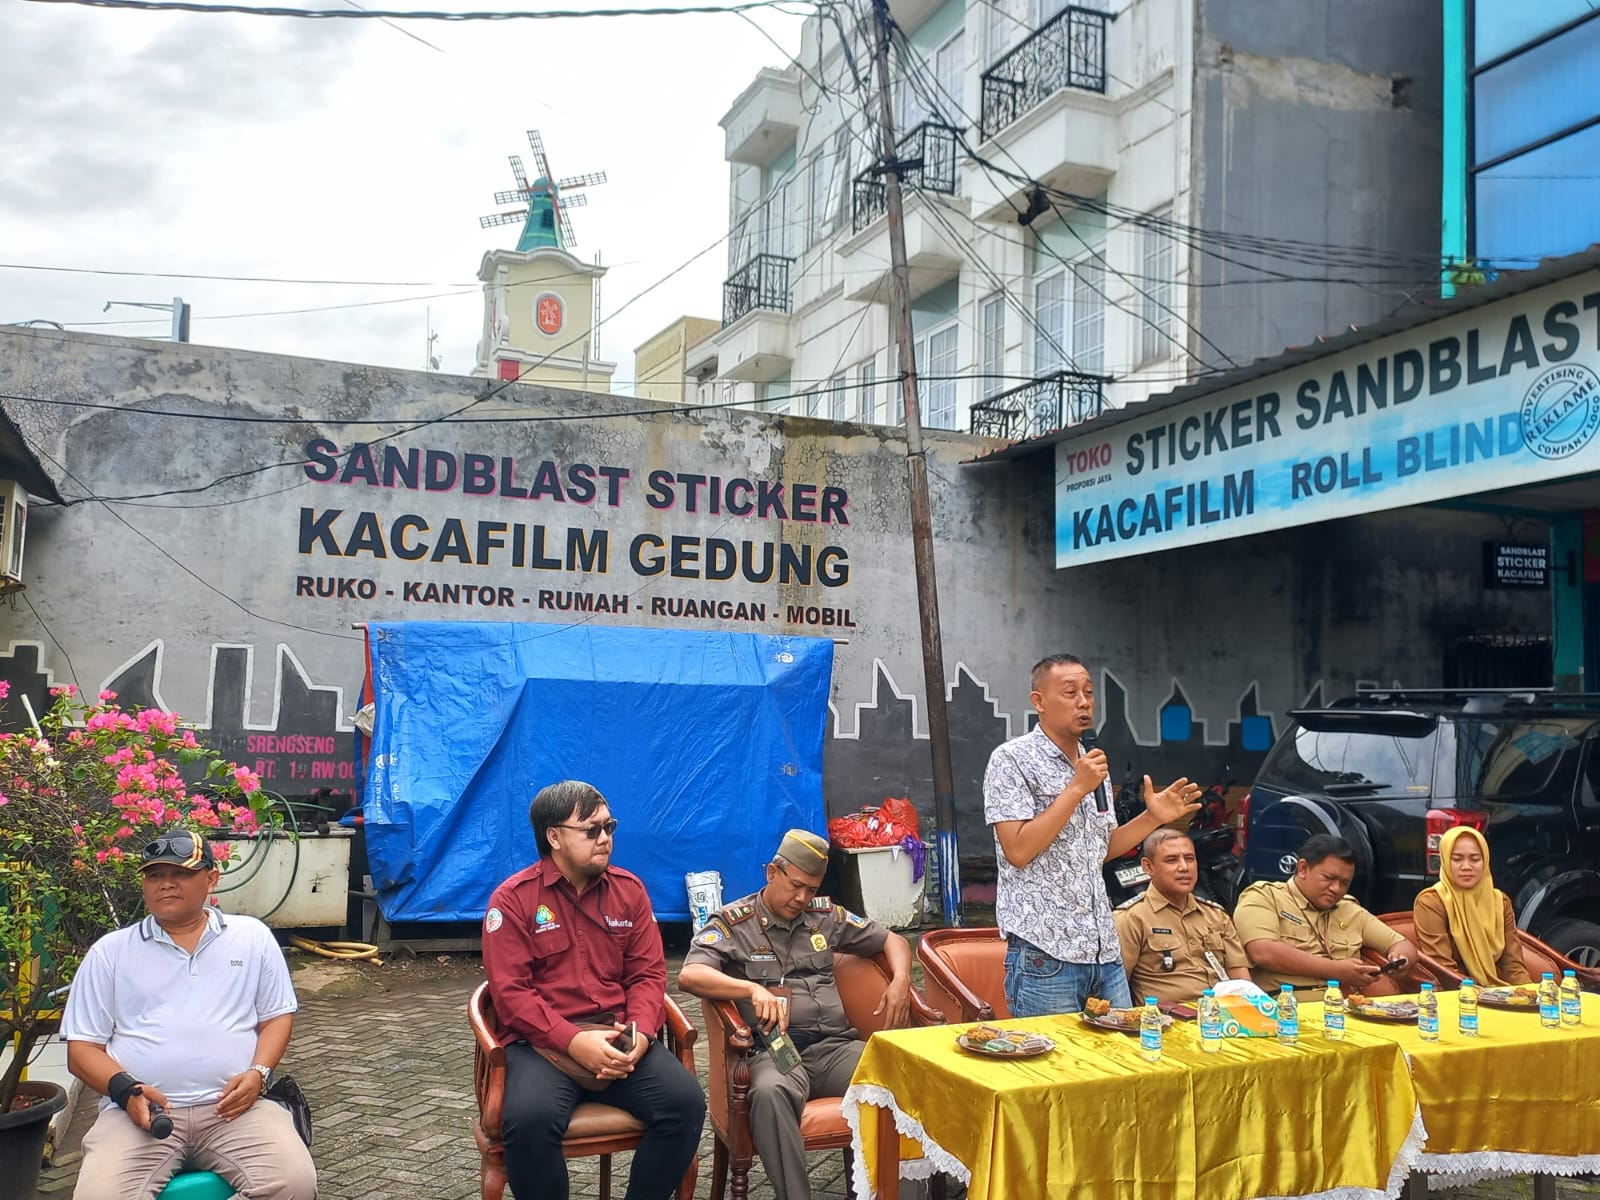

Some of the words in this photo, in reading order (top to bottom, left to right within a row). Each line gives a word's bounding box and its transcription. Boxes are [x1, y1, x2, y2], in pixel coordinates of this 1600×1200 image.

[1523, 368, 1584, 426] ADVERTISING
[1526, 378, 1597, 444] REKLAME
[1125, 391, 1282, 477] STICKER
[1537, 430, 1588, 455] COMPANY
[1587, 395, 1600, 430] LOGO
[303, 438, 630, 508] SANDBLAST
[645, 469, 850, 526] STICKER
[1066, 443, 1112, 475] TOKO
[1073, 469, 1256, 550] KACAFILM
[1291, 447, 1383, 500] ROLL
[1396, 411, 1524, 478] BLIND
[298, 506, 610, 575] KACAFILM
[629, 533, 851, 588] GEDUNG
[1497, 556, 1546, 569] STICKER
[1497, 569, 1544, 580] KACAFILM
[1500, 546, 1546, 557] SANDBLAST
[296, 575, 377, 600] RUKO
[402, 581, 515, 609] KANTOR
[538, 590, 630, 615] RUMAH
[651, 597, 767, 623] RUANGAN
[787, 604, 857, 628] MOBIL
[247, 735, 335, 754] SRENGSENG
[311, 761, 335, 778] RW
